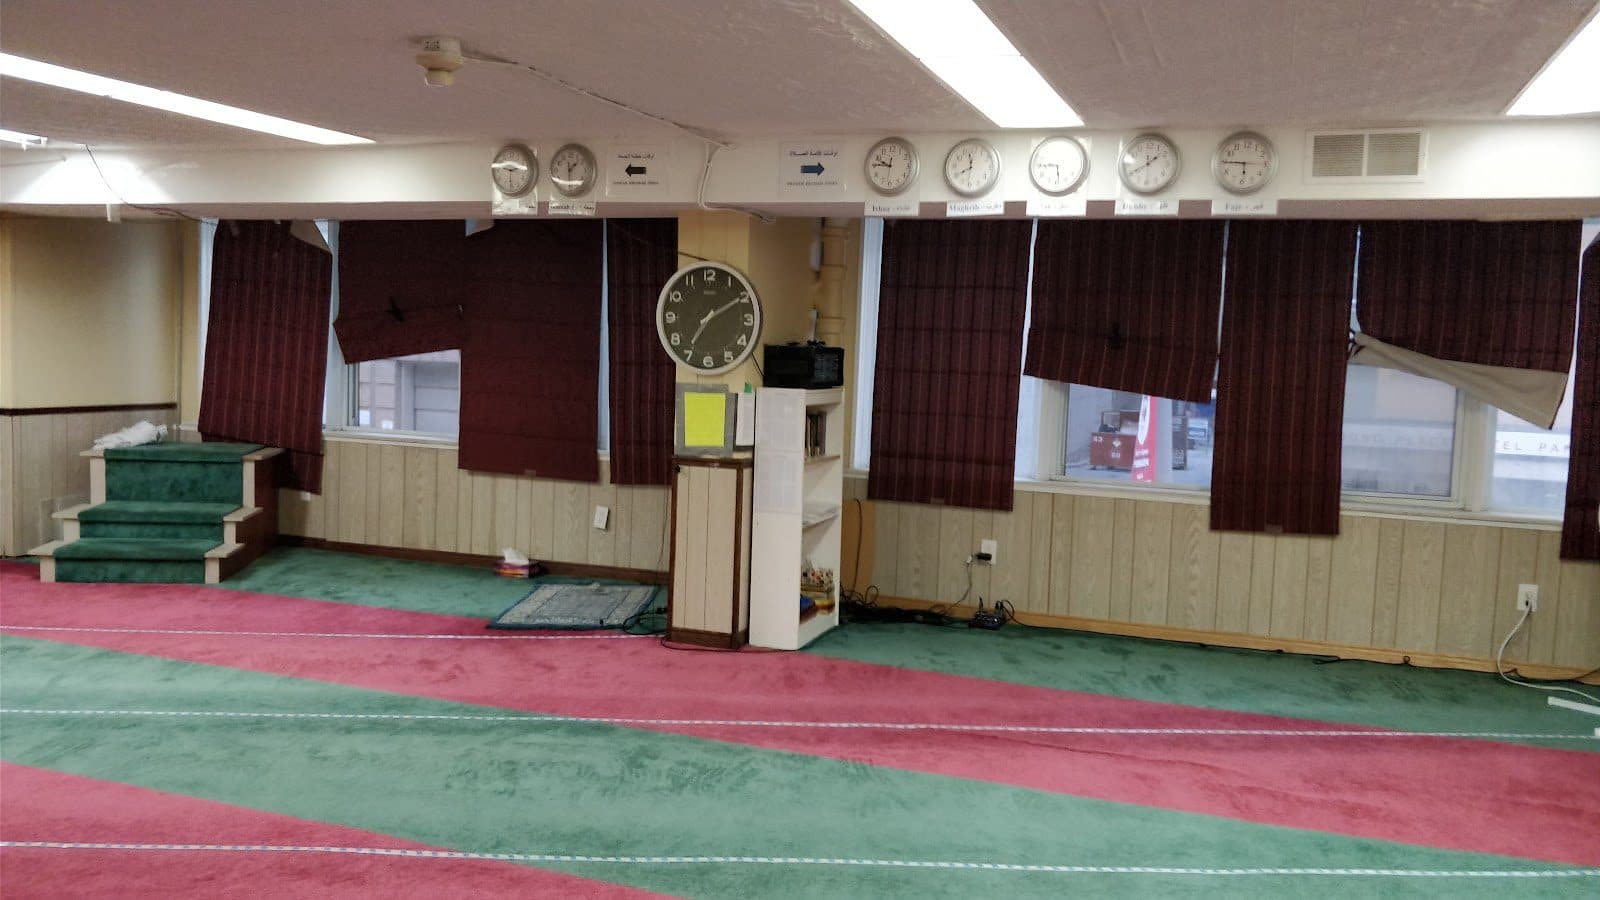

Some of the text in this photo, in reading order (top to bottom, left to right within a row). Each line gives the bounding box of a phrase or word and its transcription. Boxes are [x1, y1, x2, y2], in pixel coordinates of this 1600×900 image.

[685, 274, 694, 287] 11
[703, 269, 716, 281] 12
[727, 276, 732, 288] 1
[669, 290, 682, 303] 10
[739, 291, 750, 304] 2
[665, 311, 676, 324] 9
[743, 313, 754, 327] 3
[670, 332, 681, 346] 8
[736, 333, 748, 347] 4
[683, 349, 693, 362] 7
[702, 355, 714, 368] 6
[723, 350, 734, 363] 5
[1497, 440, 1522, 451] EL
